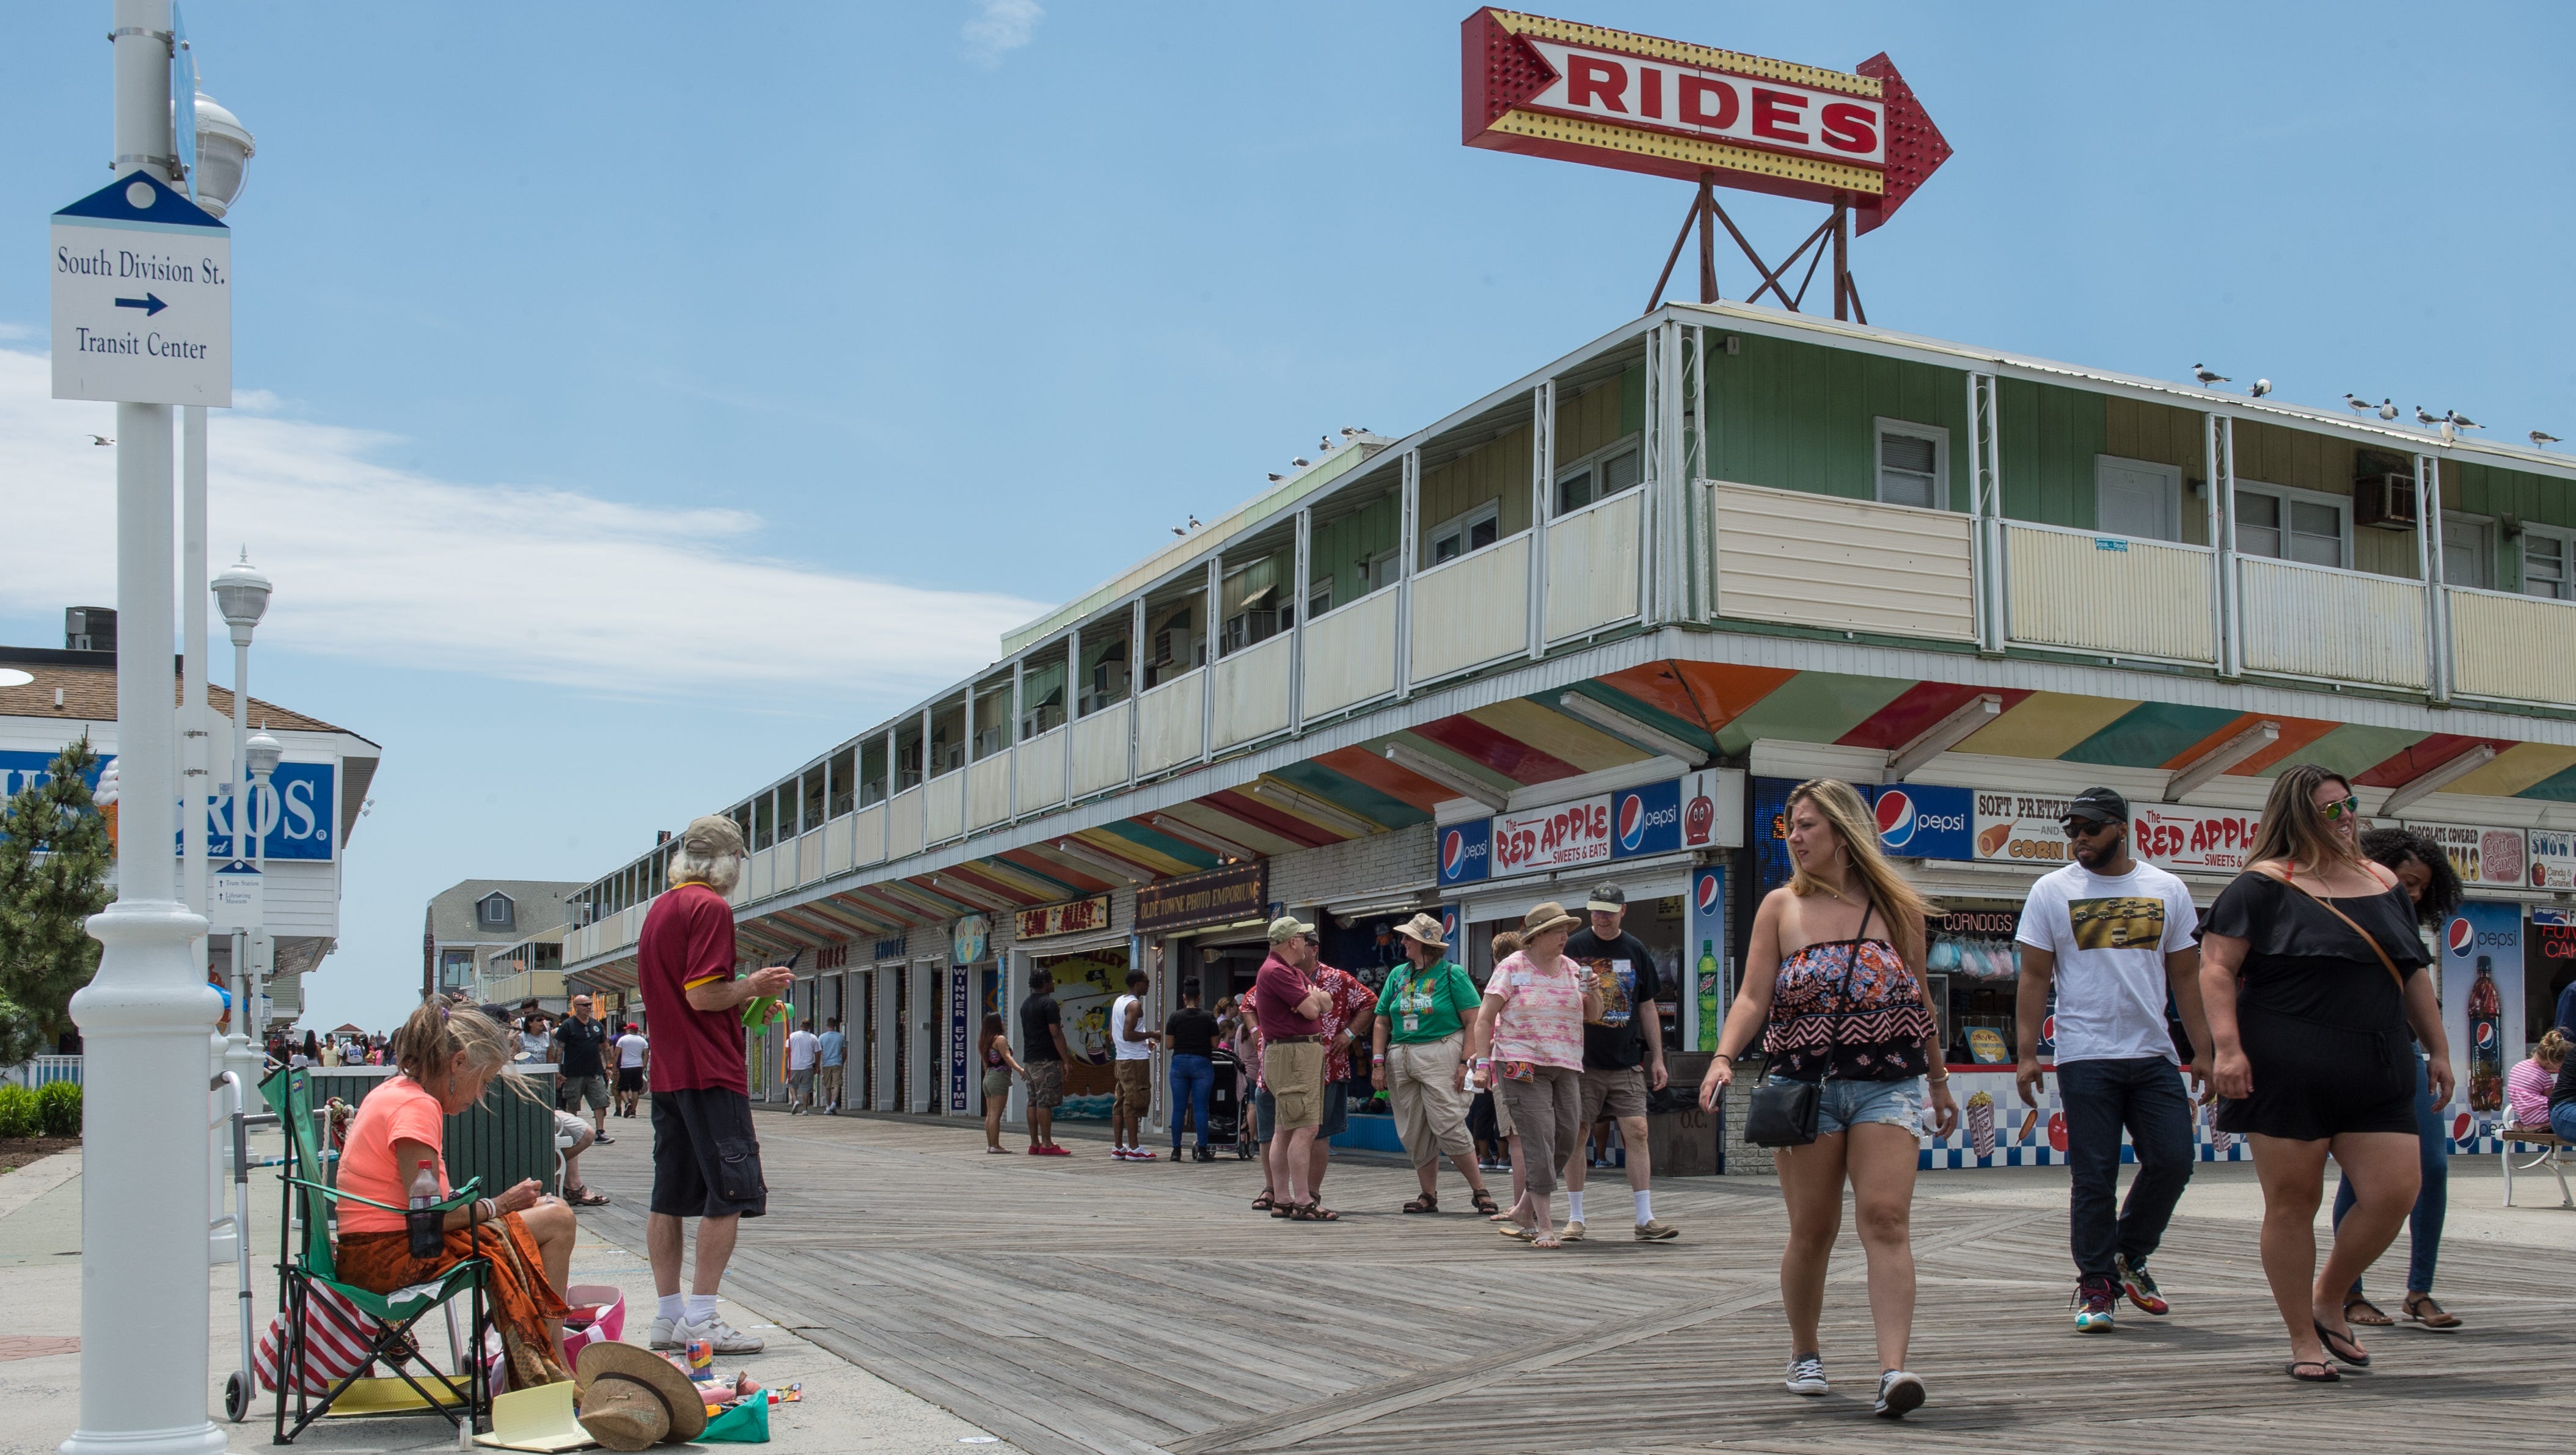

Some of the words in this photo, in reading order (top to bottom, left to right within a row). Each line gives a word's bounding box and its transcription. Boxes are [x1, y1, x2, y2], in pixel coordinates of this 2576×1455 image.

[1567, 53, 1878, 154] RIDES
[57, 246, 112, 276] South
[119, 250, 194, 283] Division
[202, 258, 225, 285] St.
[76, 327, 139, 355] Transit
[147, 332, 207, 359] Center
[1645, 804, 1677, 830] pepsi
[1978, 795, 2012, 817] SOFT
[2017, 798, 2075, 820] PRETZE
[2146, 810, 2161, 823] The
[1505, 819, 1517, 833] The
[1917, 814, 1964, 833] pepsi
[2040, 825, 2060, 836] AND
[1496, 830, 1536, 870] RED
[1540, 804, 1608, 853] APPLE
[2135, 818, 2185, 860] RED
[2190, 817, 2260, 854] APPLE
[2407, 825, 2447, 843] CHOCOLATE
[2448, 827, 2478, 844] COVERED
[2531, 831, 2569, 856] SNOW
[1464, 840, 1487, 862] pepsi
[1553, 847, 1581, 864] SWEETS
[1582, 847, 1588, 859] &
[1589, 843, 1608, 858] EATS
[2008, 839, 2064, 860] CORN
[2483, 836, 2520, 856] Cotton
[2205, 853, 2235, 867] SWEETS
[2236, 856, 2242, 867] &
[2486, 855, 2520, 875] Candy
[2547, 867, 2566, 880] Candy
[2547, 877, 2572, 888] Caramel
[1141, 900, 1159, 920] OLDE
[1162, 895, 1185, 915] TOWNE
[1186, 890, 1210, 913] PHOTO
[1212, 881, 1258, 906] EMPORIUM
[1025, 909, 1047, 937] CAN
[1059, 900, 1097, 933] ALLEY
[1944, 913, 2013, 932] CORNDOGS
[2478, 930, 2517, 949] pepsi
[816, 945, 847, 970] RIDES
[1085, 949, 1129, 969] ALLEY
[953, 968, 967, 1017] WINNER
[954, 1026, 965, 1067] EVERY
[953, 1075, 965, 1108] TIME
